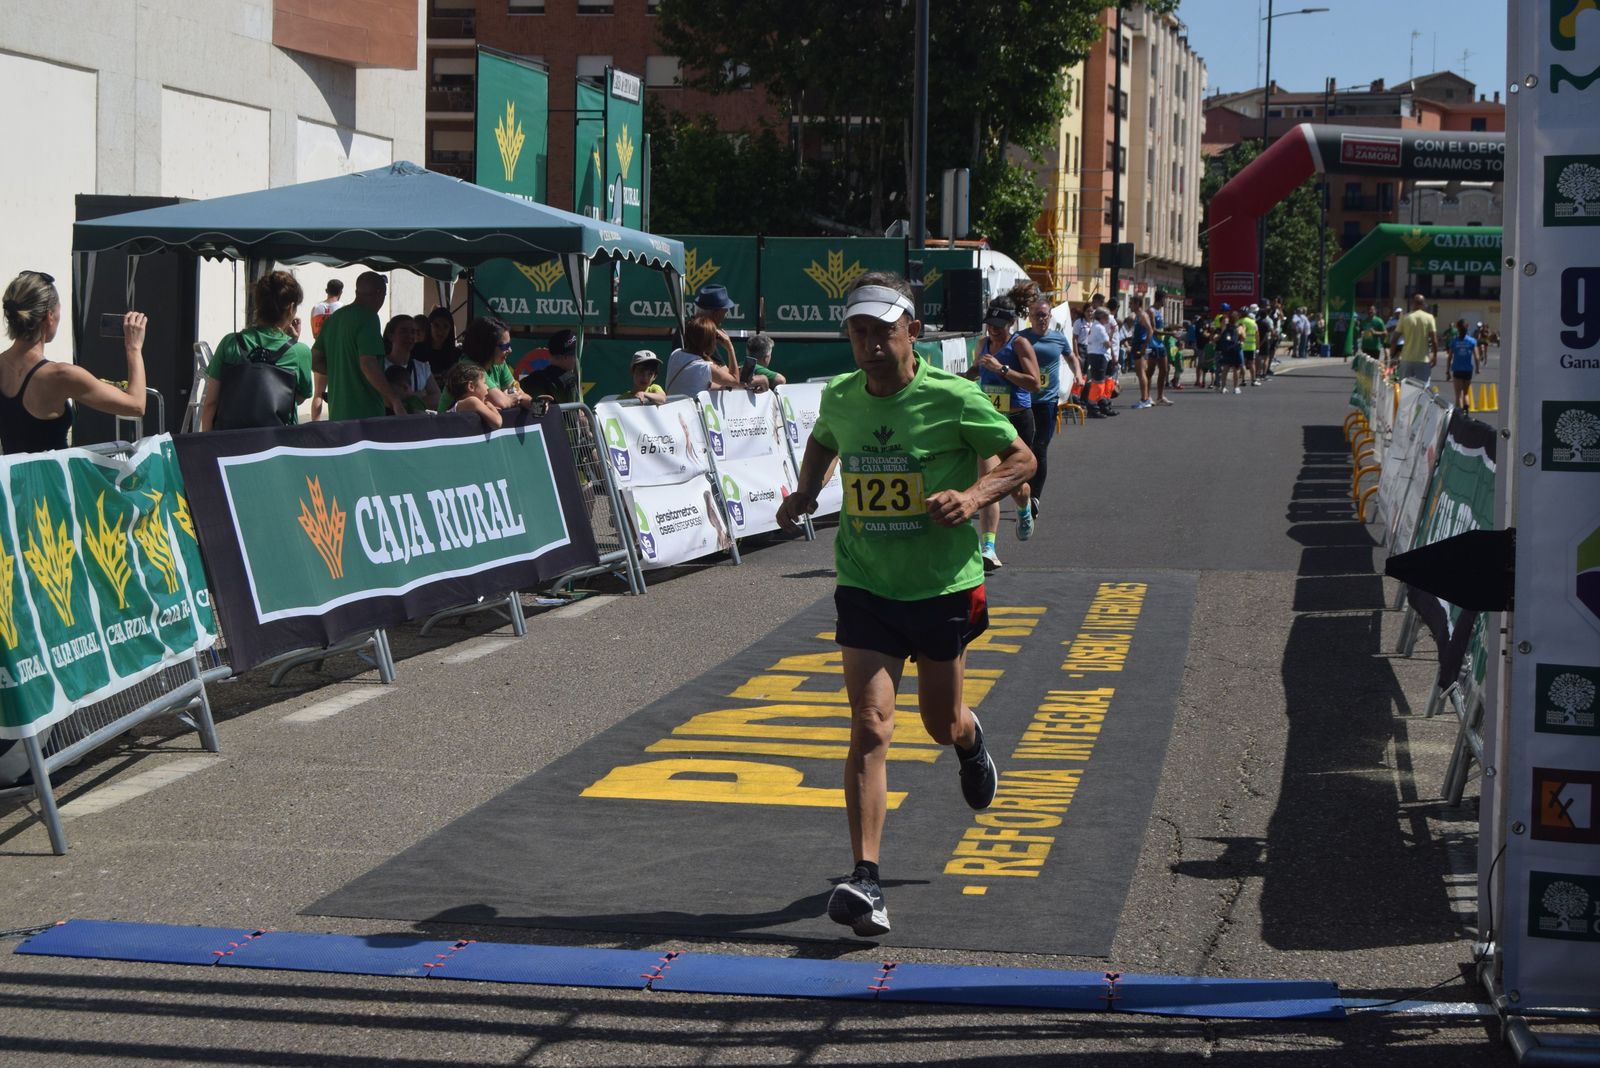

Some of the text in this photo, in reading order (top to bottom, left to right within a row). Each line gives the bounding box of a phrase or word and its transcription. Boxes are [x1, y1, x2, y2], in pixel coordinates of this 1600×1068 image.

[1414, 139, 1445, 152] CON
[1449, 141, 1465, 153] EL
[1355, 151, 1398, 162] ZAMORA
[1413, 156, 1482, 170] GANAMOS
[1434, 233, 1472, 248] CAJA
[1427, 259, 1496, 272] SALIDA
[487, 297, 531, 314] CAJA
[629, 300, 676, 318] CAJA
[777, 305, 824, 322] CAJA
[883, 464, 908, 472] RURAL
[851, 478, 911, 512] 123
[354, 478, 527, 565] CAJA RURAL
[864, 520, 922, 532] CAJA RURAL
[1010, 687, 1116, 761] INTEGRAL
[943, 768, 1085, 878] REFORMA
